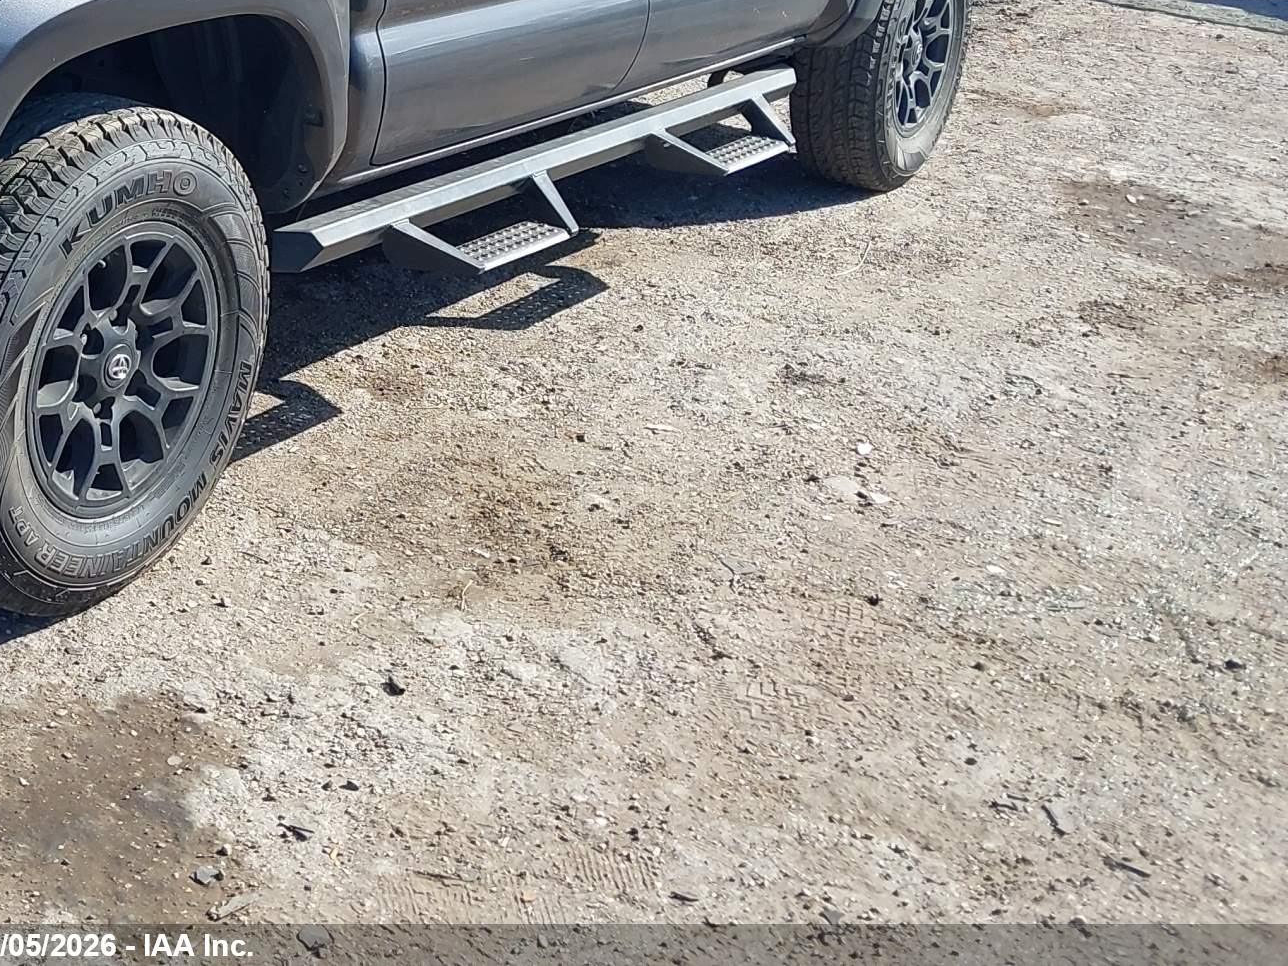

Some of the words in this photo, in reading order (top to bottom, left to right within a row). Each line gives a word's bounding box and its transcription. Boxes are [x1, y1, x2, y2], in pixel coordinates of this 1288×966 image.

[59, 169, 197, 259] KUMHO
[209, 361, 252, 466] MAVIS
[9, 505, 40, 547] APT
[34, 471, 207, 579] MOUNTAINEER
